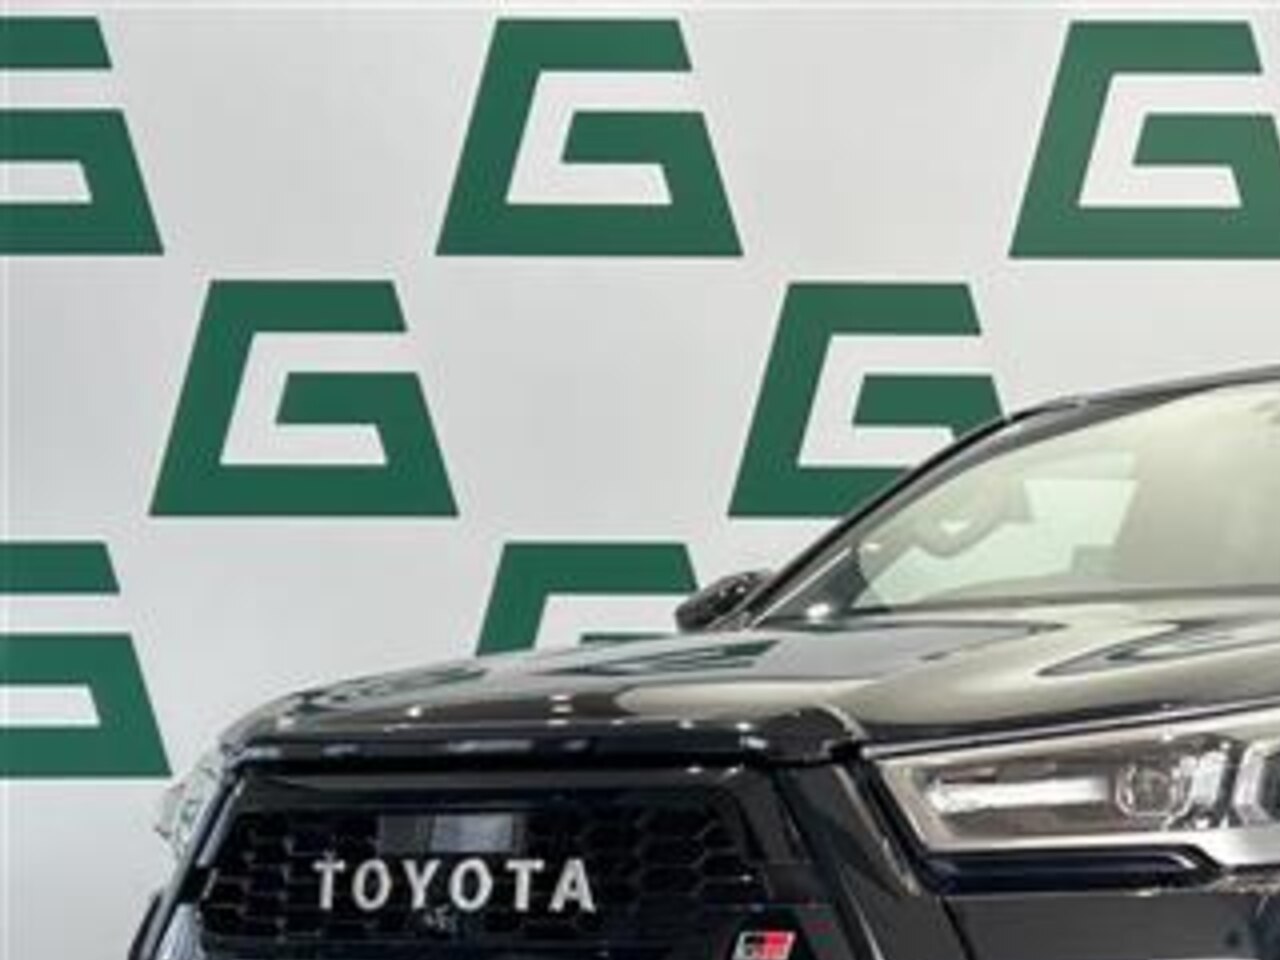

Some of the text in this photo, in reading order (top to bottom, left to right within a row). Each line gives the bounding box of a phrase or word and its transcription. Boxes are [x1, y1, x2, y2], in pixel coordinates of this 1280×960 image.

[436, 19, 744, 257] G
[149, 280, 459, 517] G
[312, 856, 597, 912] TOYOTA
